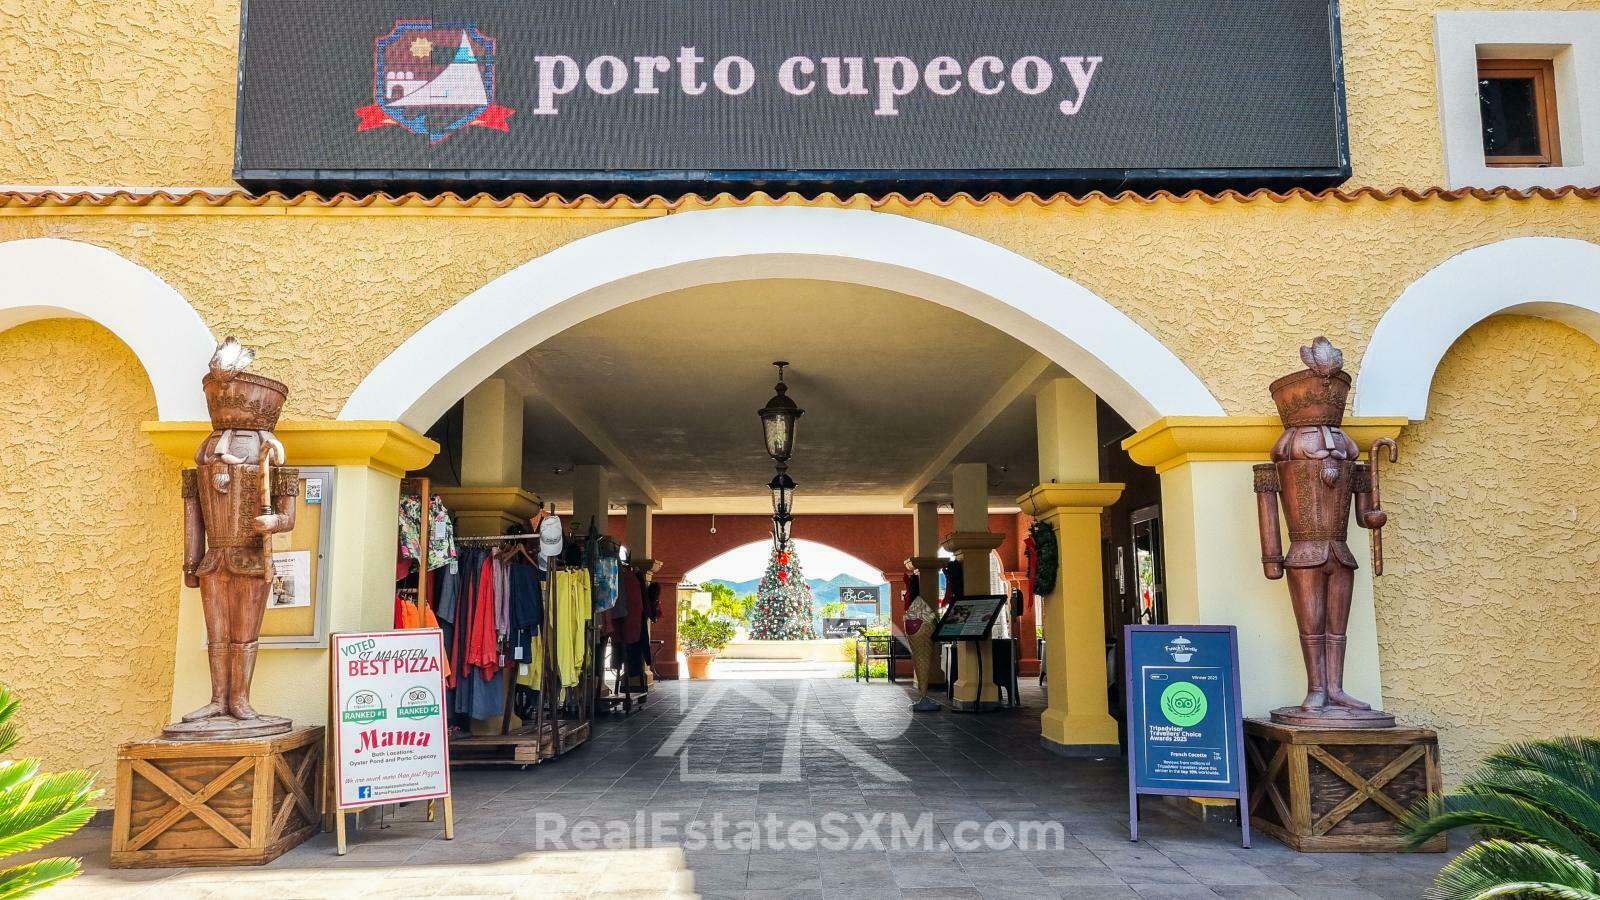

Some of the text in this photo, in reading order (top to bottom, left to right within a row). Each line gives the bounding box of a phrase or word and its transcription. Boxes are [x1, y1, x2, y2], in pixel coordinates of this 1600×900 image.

[534, 46, 1103, 116] porto cupecoy
[341, 638, 376, 657] VOTED
[374, 648, 428, 662] MAARTEN
[348, 656, 440, 677] BEST PIZZA
[345, 710, 385, 720] RANKED #1
[399, 706, 429, 716] RANKED
[354, 729, 431, 754] Mama
